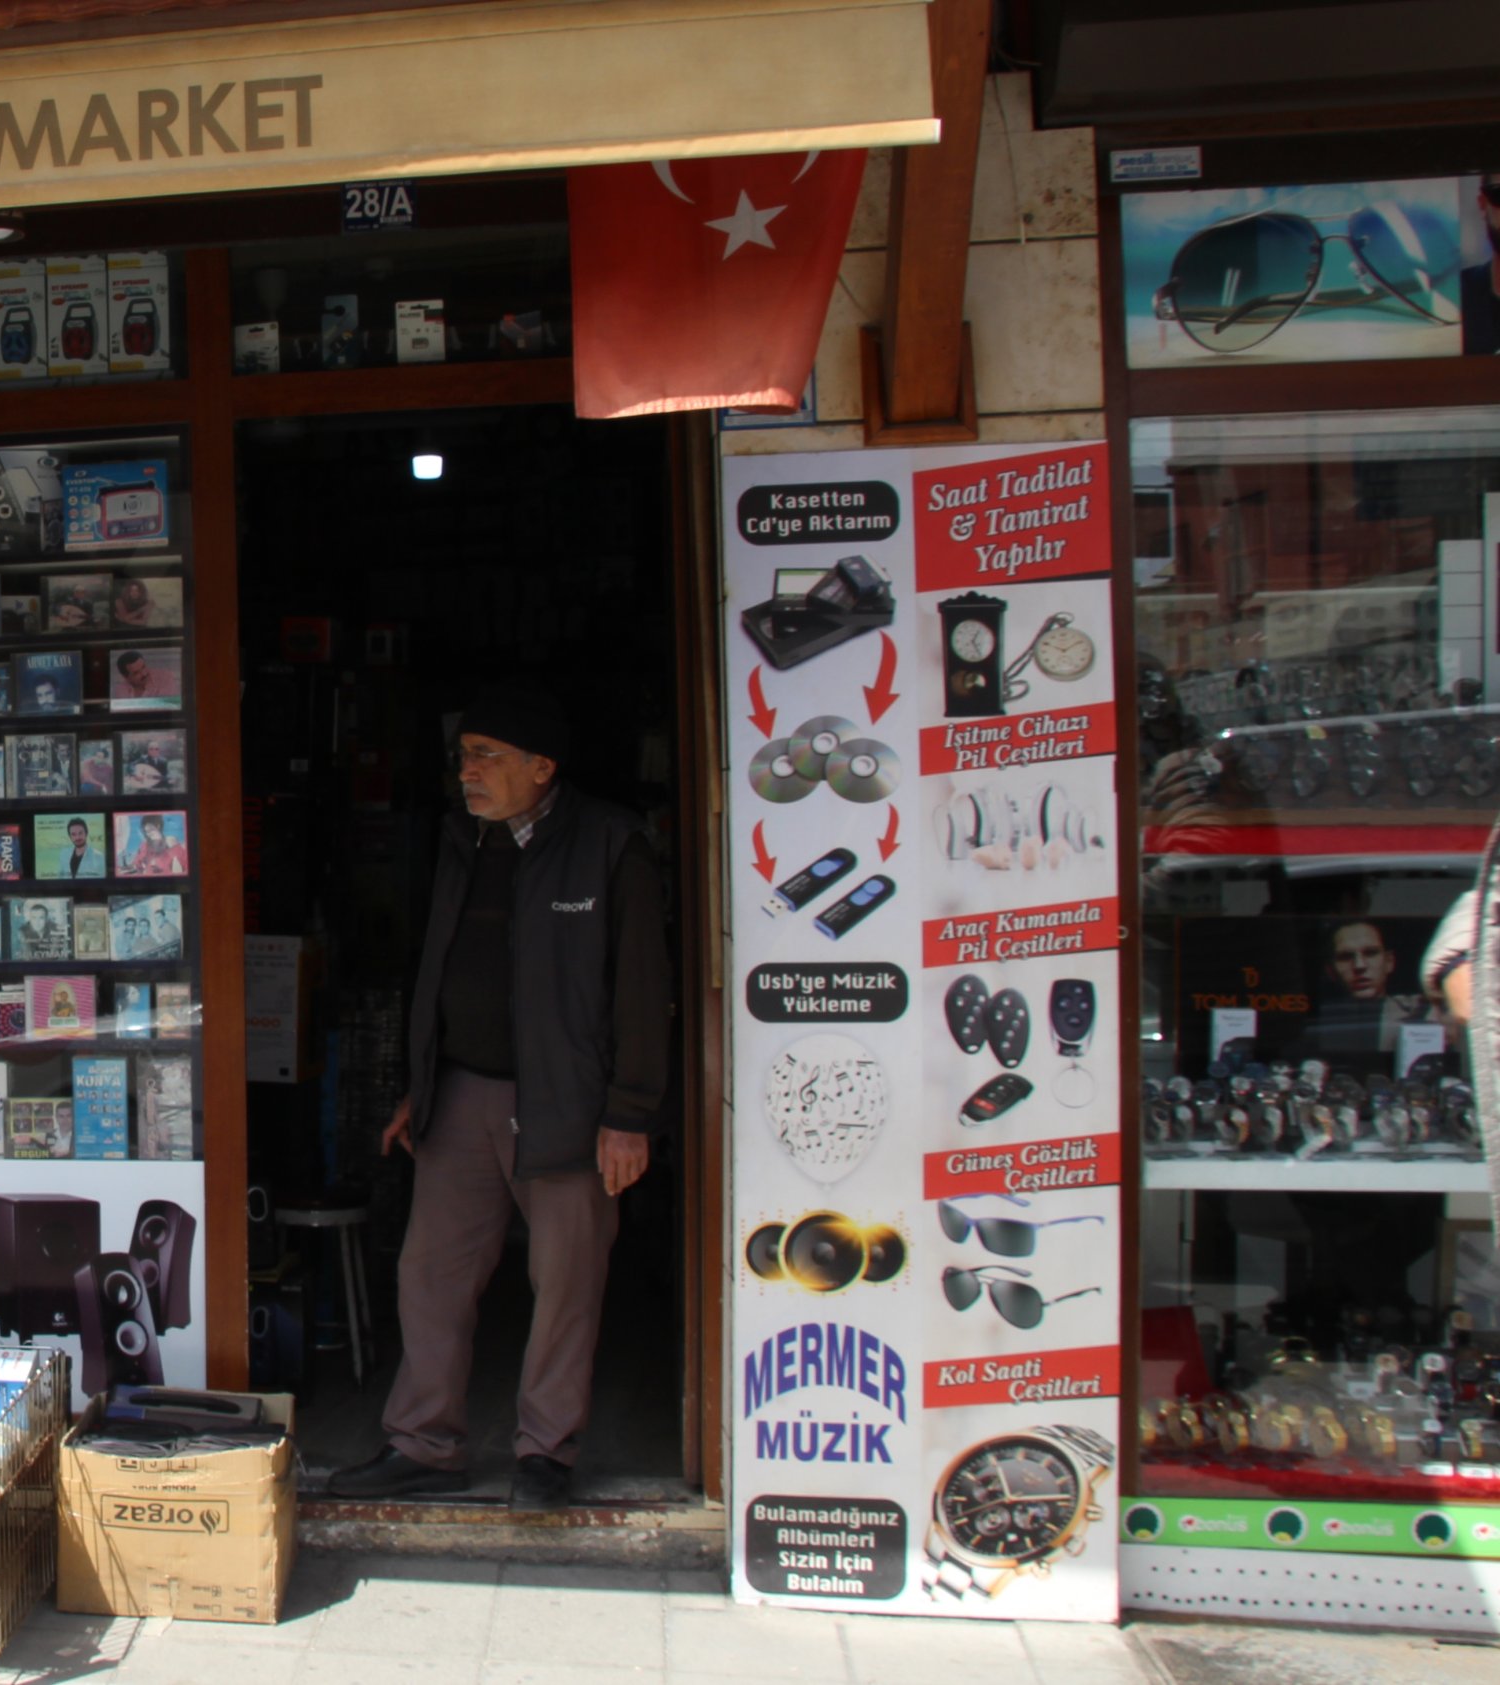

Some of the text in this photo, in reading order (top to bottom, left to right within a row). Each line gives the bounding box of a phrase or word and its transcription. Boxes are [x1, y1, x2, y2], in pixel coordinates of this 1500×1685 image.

[345, 186, 414, 219] 28/A
[770, 492, 865, 510] Kasetten
[928, 459, 1092, 511] Saat Tadilat
[746, 514, 892, 537] Cd'ye Aktarım
[948, 495, 1089, 542] & Tamirat
[975, 537, 1066, 576] Yapılır
[944, 714, 1089, 754] İşitme Cihazı
[955, 739, 1085, 772] Pil Çeşitleri
[1, 835, 13, 872] RAKS
[939, 904, 1101, 942] Araç Kumanda
[956, 931, 1084, 963] Pil Çeşitleri
[758, 971, 896, 993] Usb'ye Müzik
[783, 996, 872, 1013] Yükleme
[1191, 993, 1310, 1013] TOM JONES
[945, 1139, 1098, 1178] Güneş Gözlük
[1004, 1162, 1096, 1195] Çeşitleri
[743, 1322, 907, 1424] MERMER
[938, 1358, 1042, 1387] Kol Saati
[1008, 1375, 1102, 1405] Çeşitleri
[755, 1409, 893, 1465] MÜZİK
[113, 1503, 194, 1525] orgaz
[753, 1504, 899, 1528] Bulamadığınız
[776, 1529, 876, 1549] Albümleri
[778, 1550, 874, 1576] Sizin İçin
[786, 1574, 865, 1595] Bulalım
